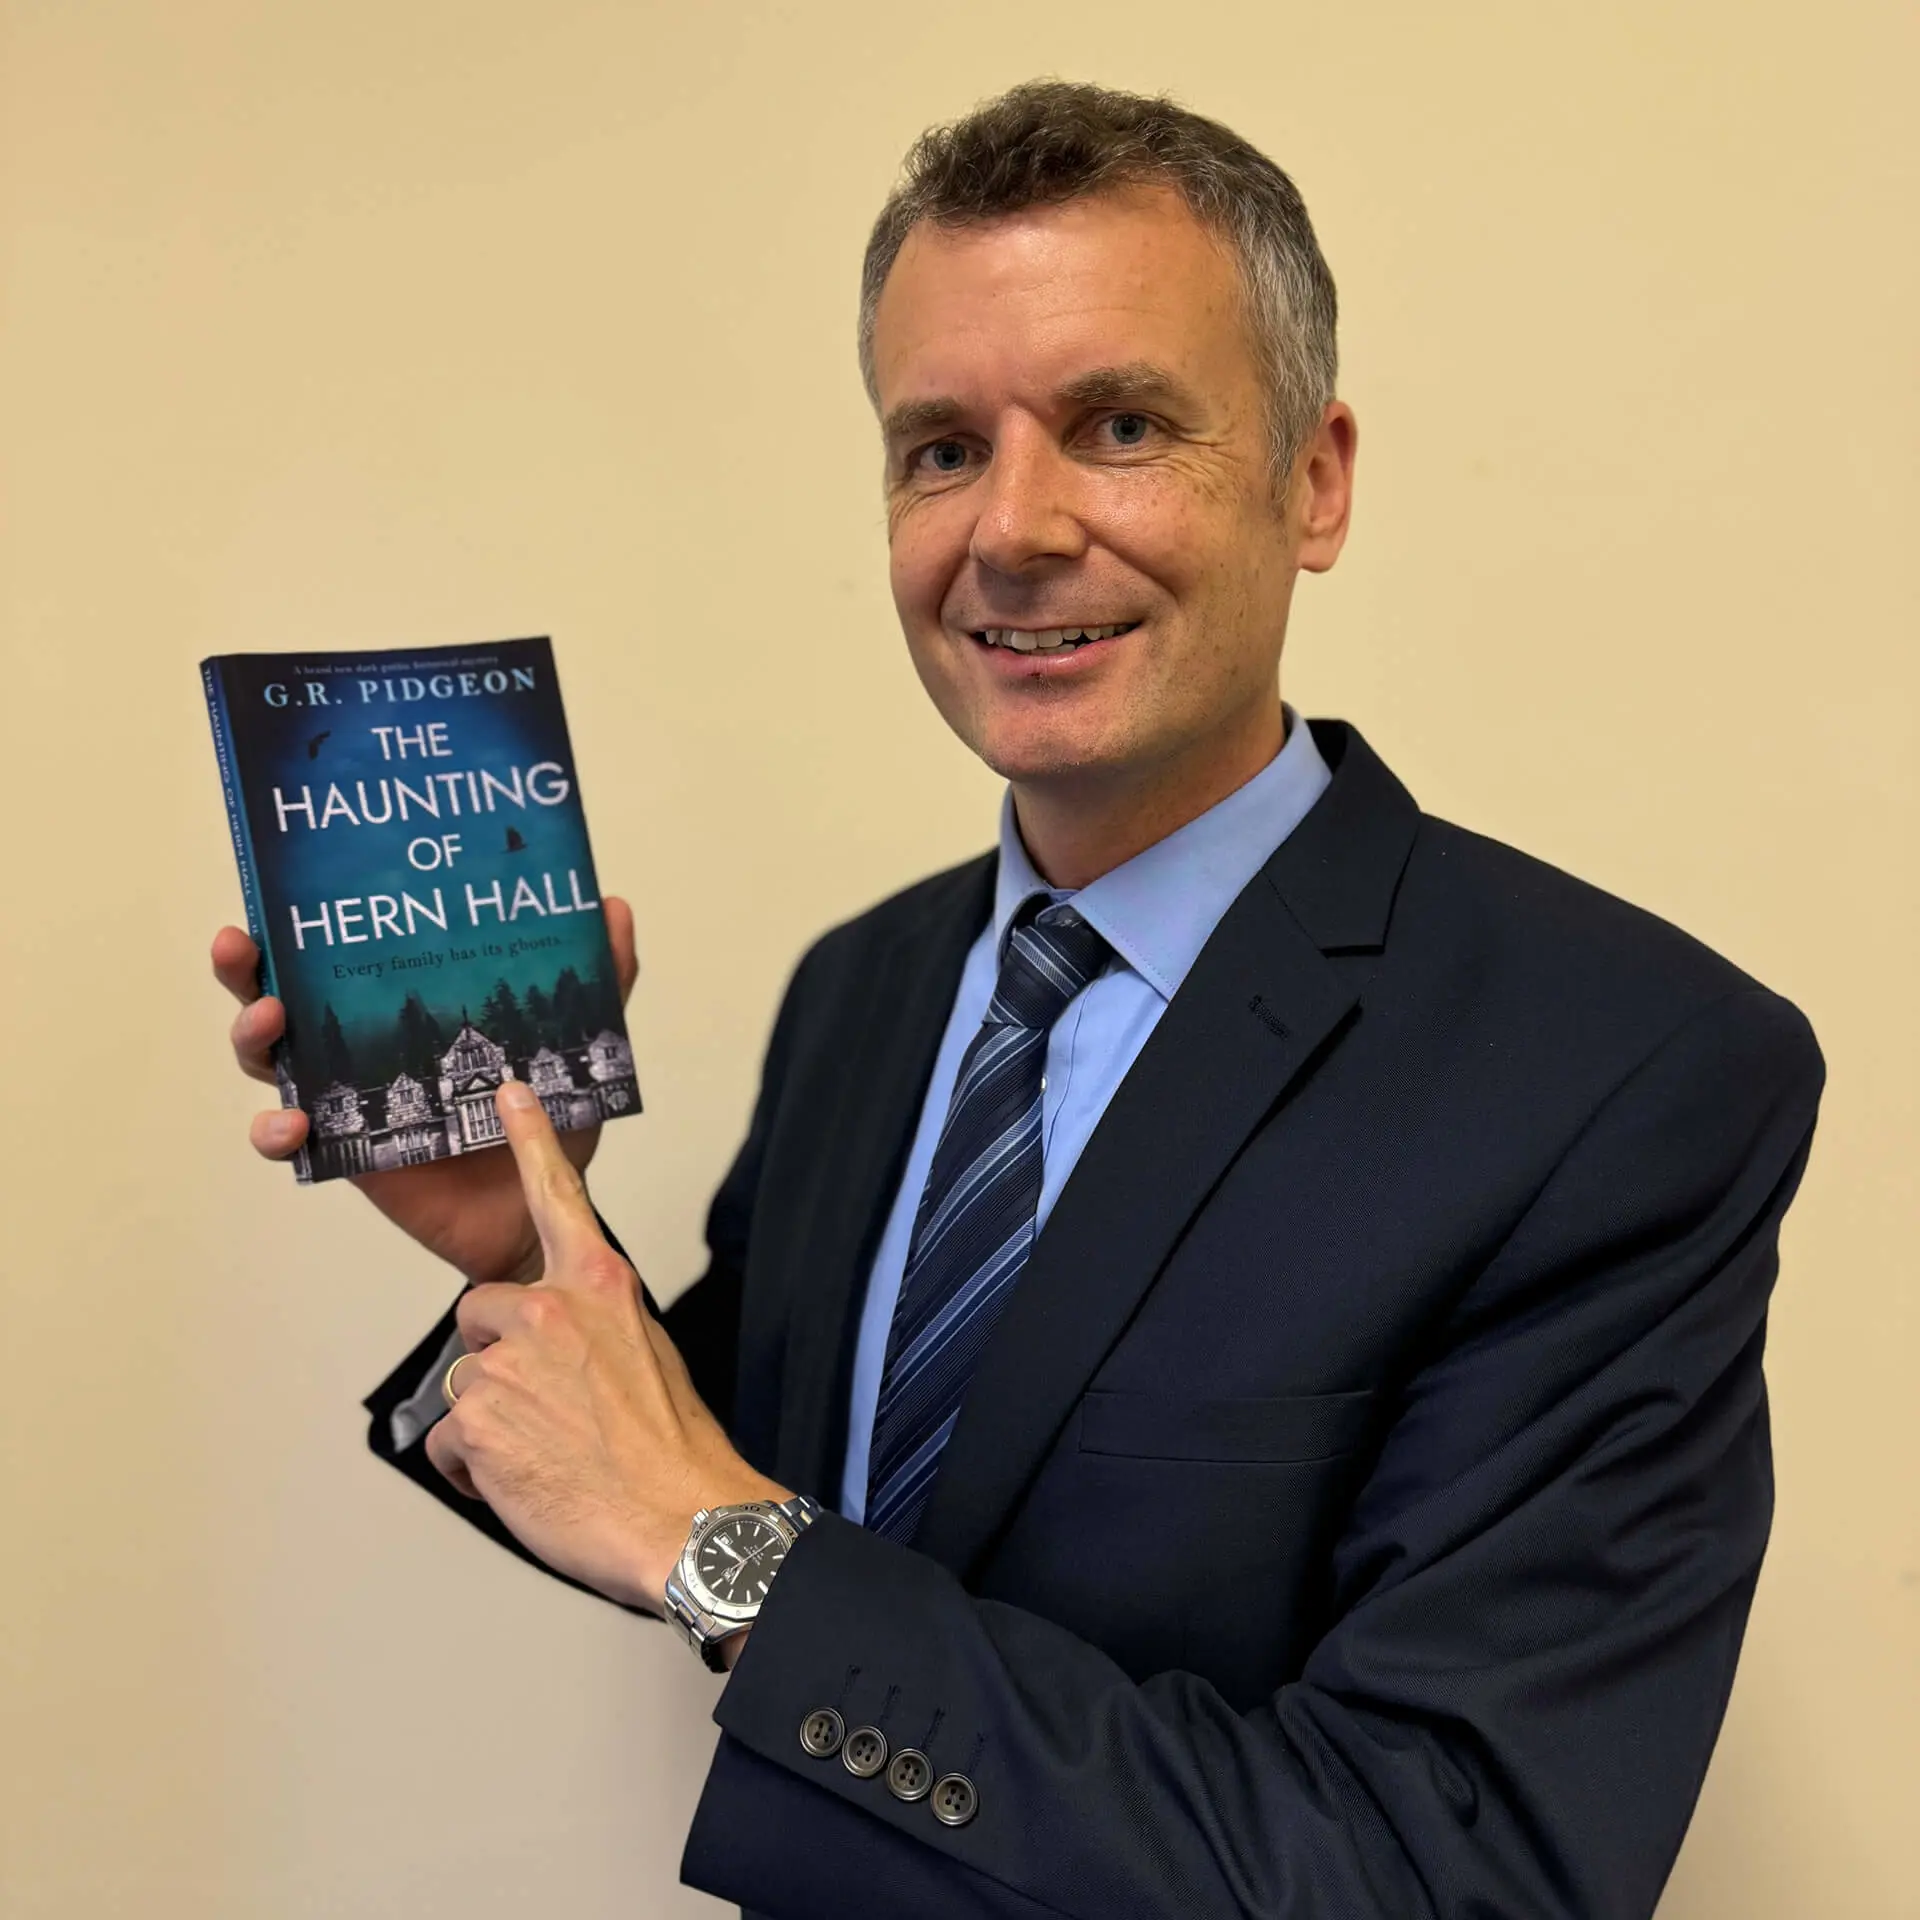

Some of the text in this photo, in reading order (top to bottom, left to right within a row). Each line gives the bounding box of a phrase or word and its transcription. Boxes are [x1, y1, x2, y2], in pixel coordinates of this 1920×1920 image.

[264, 666, 536, 708] G.R. PIDGEON
[355, 663, 378, 674] dark
[370, 722, 453, 760] THE
[272, 761, 570, 832] HAUNTING
[407, 833, 463, 871] OF
[289, 869, 599, 950] HERN HALL
[333, 963, 386, 980] Every
[391, 951, 445, 971] family
[449, 947, 477, 961] has
[482, 943, 503, 957] its
